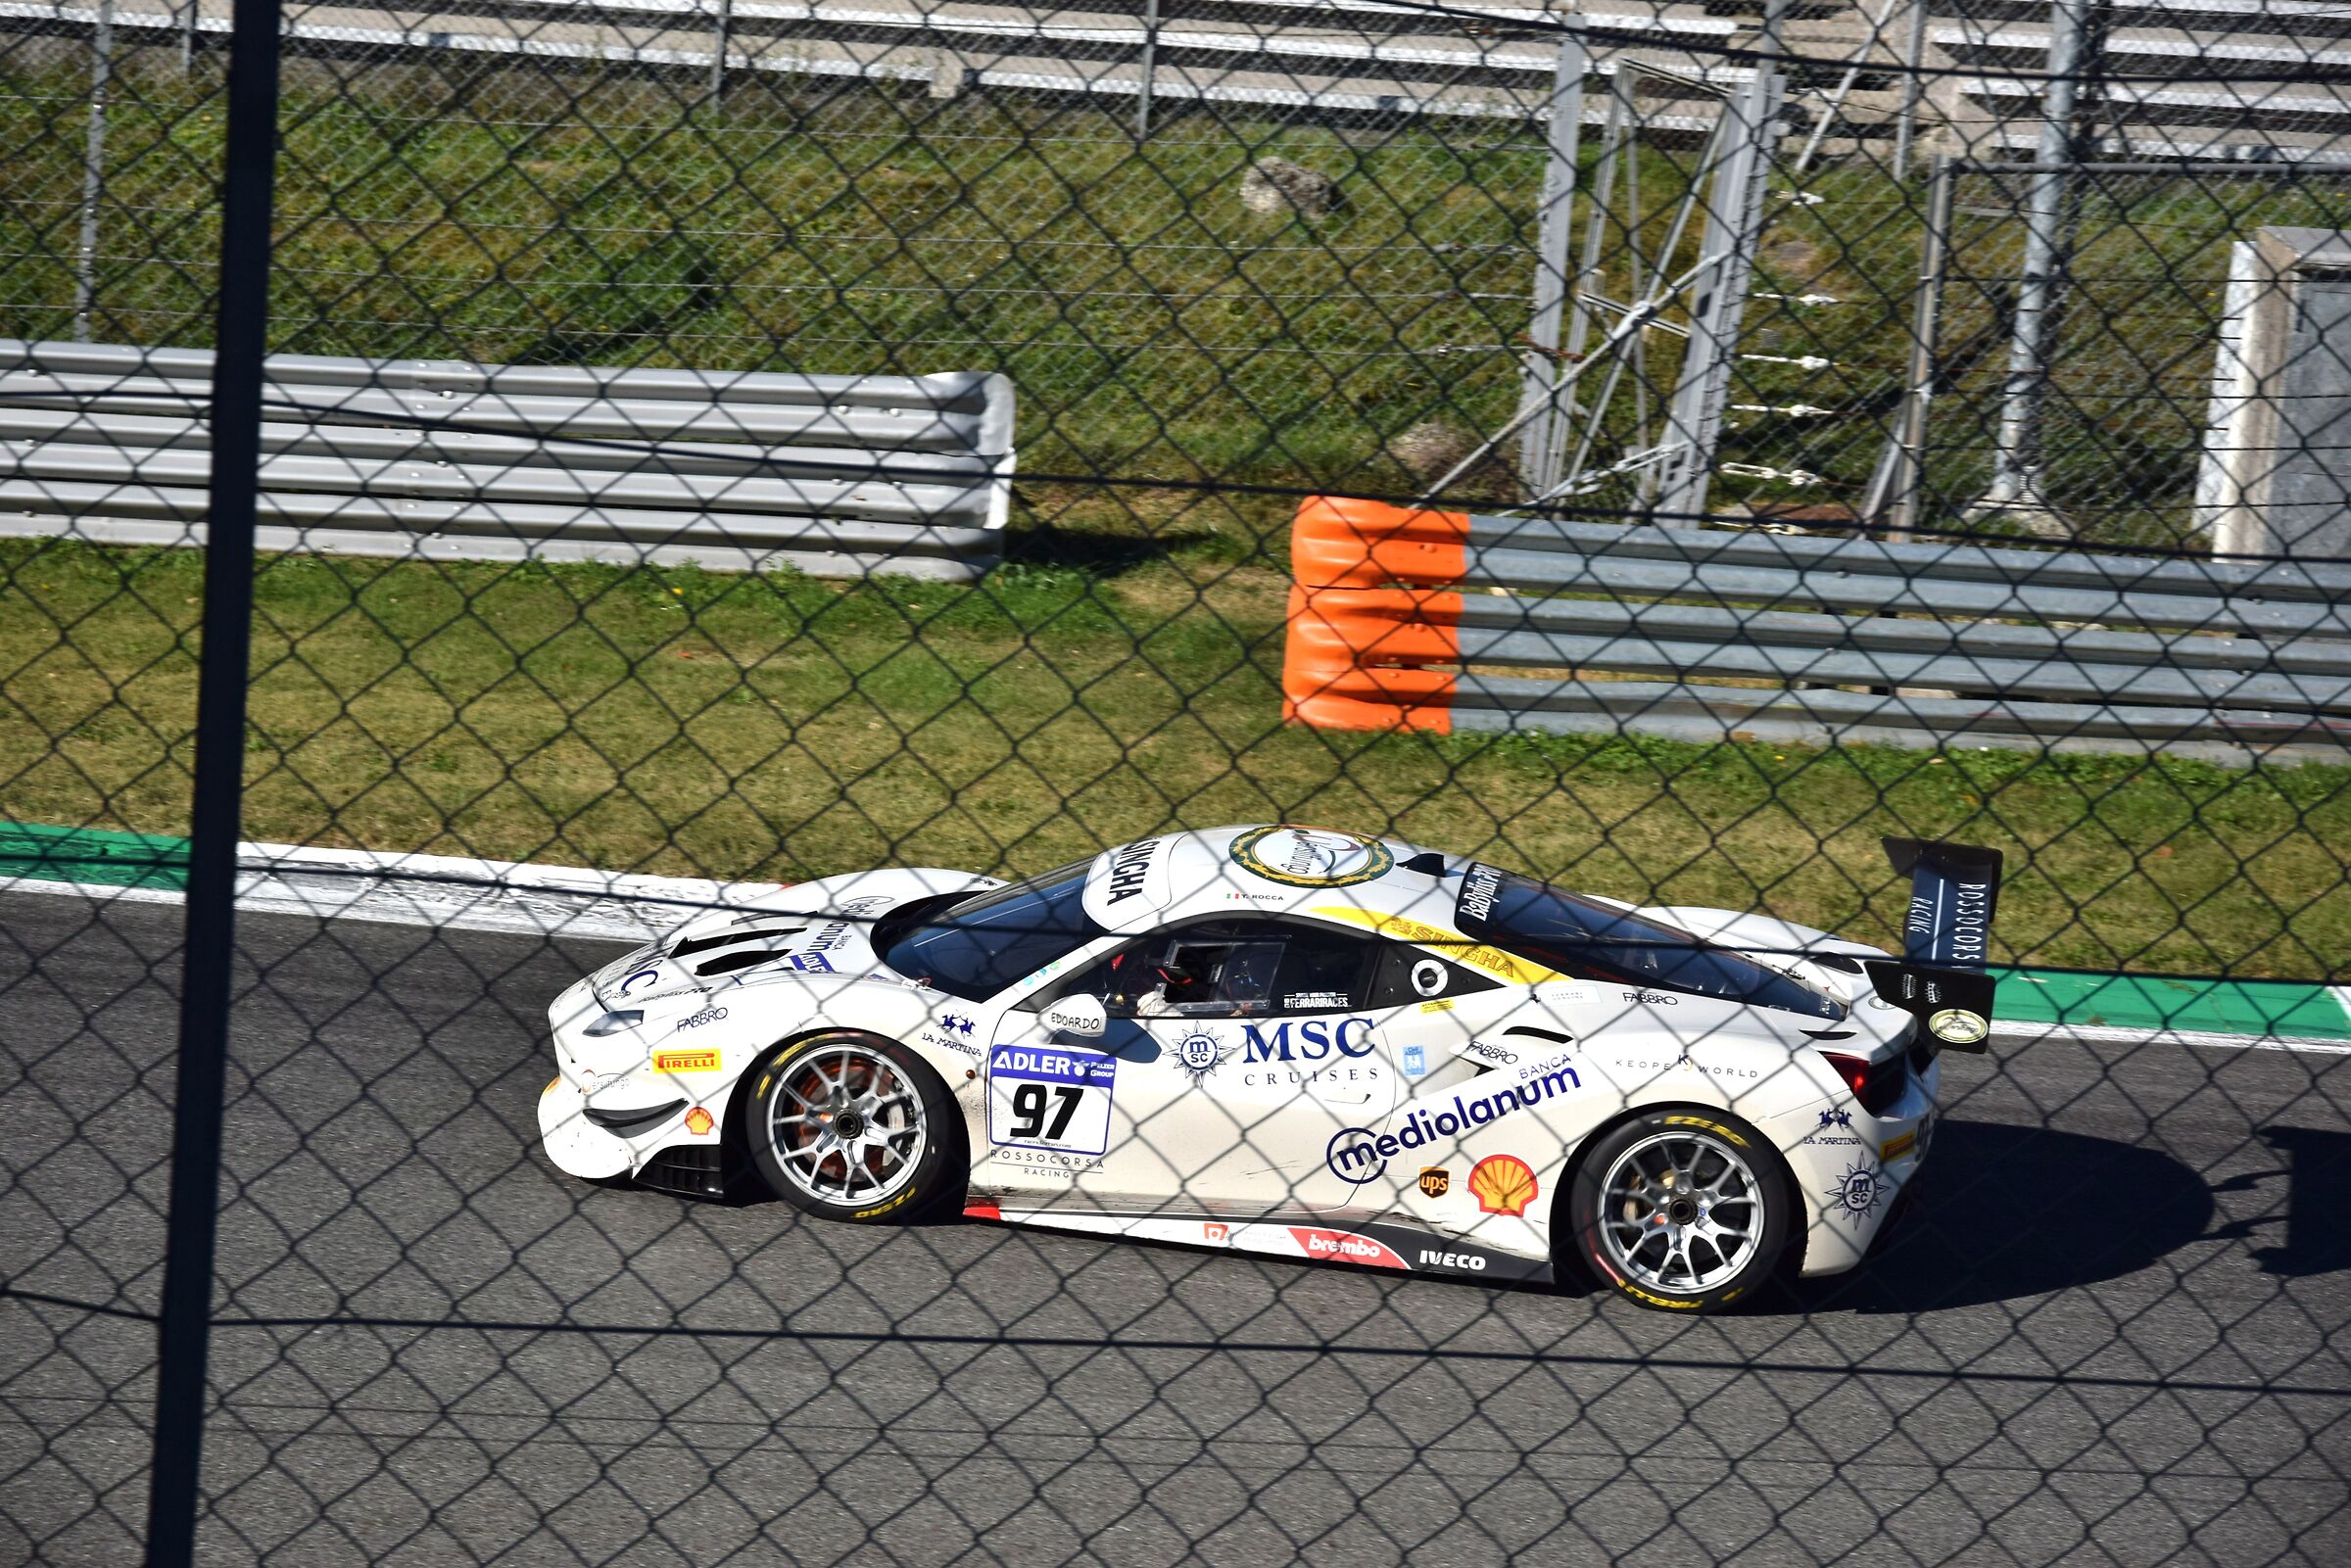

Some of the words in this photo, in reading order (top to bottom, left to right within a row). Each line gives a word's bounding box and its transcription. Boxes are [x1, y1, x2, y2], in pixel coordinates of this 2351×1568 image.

[1108, 841, 1161, 906] SINGHA
[1908, 896, 1934, 934] RACING
[1951, 882, 1987, 969] ROSSOCORS
[1622, 992, 1679, 1006] FABBRO
[677, 1007, 728, 1033] FABBRO
[1050, 1013, 1100, 1030] EDOARDO
[922, 1032, 936, 1044] LA
[936, 1038, 983, 1058] MARTINA
[1240, 1018, 1376, 1064] MSC
[1467, 1040, 1518, 1065] FABBRO
[657, 1053, 715, 1069] PIRELLI
[992, 1051, 1072, 1076] ADLER
[1519, 1054, 1572, 1079] BANCA
[1698, 1066, 1758, 1078] WORLD
[1244, 1069, 1378, 1087] CRUISES
[1010, 1083, 1084, 1140] 97
[1331, 1067, 1581, 1178] mediolanum
[990, 1149, 1104, 1168] ROSSOCORSA
[1024, 1168, 1070, 1179] RACING
[1420, 1174, 1449, 1195] ups
[1309, 1234, 1380, 1258] brembo
[1419, 1250, 1486, 1270] IVECO
